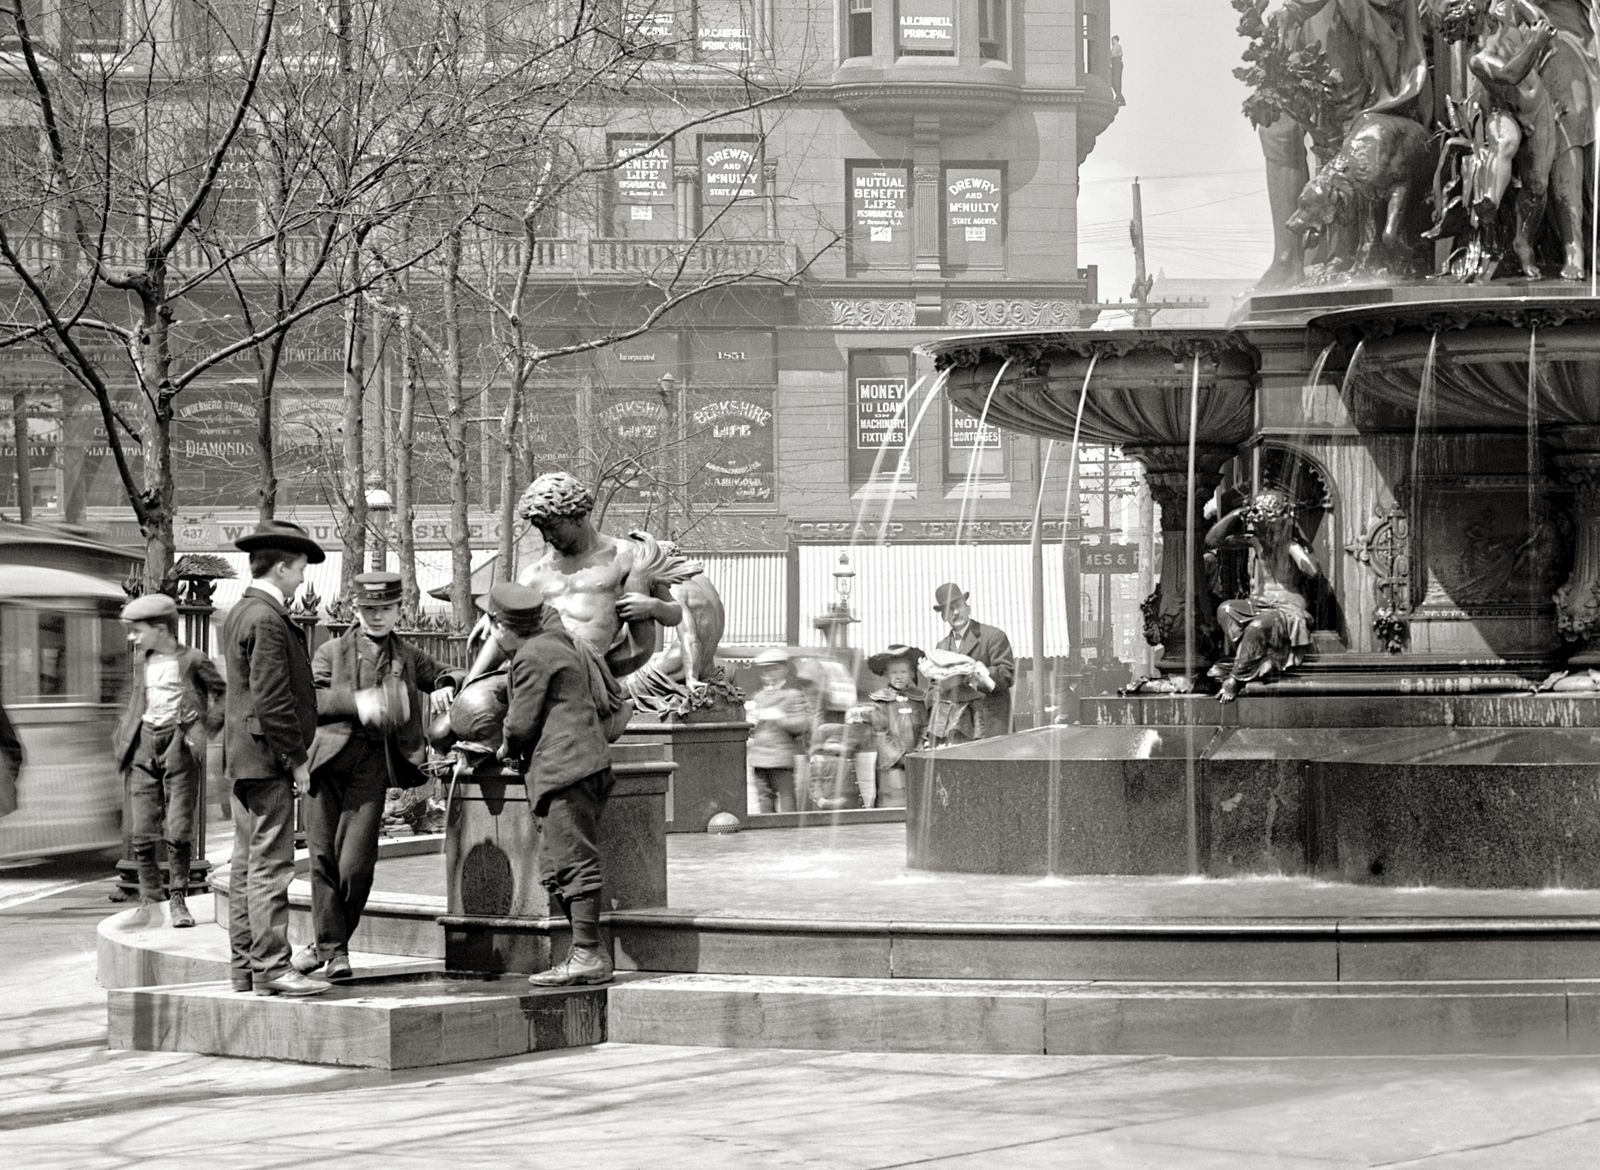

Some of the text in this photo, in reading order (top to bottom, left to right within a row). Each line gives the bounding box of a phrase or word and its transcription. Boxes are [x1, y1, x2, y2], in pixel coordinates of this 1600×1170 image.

[626, 170, 659, 180] LIFE
[856, 178, 905, 188] MUTUAL
[949, 177, 999, 196] DREWRY
[854, 189, 906, 199] BENEFIT
[864, 200, 896, 209] LIFE
[952, 217, 972, 225] STATE
[619, 353, 655, 361] Incorporated
[717, 351, 746, 360] 1851
[860, 385, 904, 399] MONEY
[861, 403, 873, 412] TO
[693, 401, 772, 426] BERKSHIRE
[862, 433, 903, 442] FIXTURES
[182, 528, 203, 540] 437
[415, 524, 482, 538] SHE
